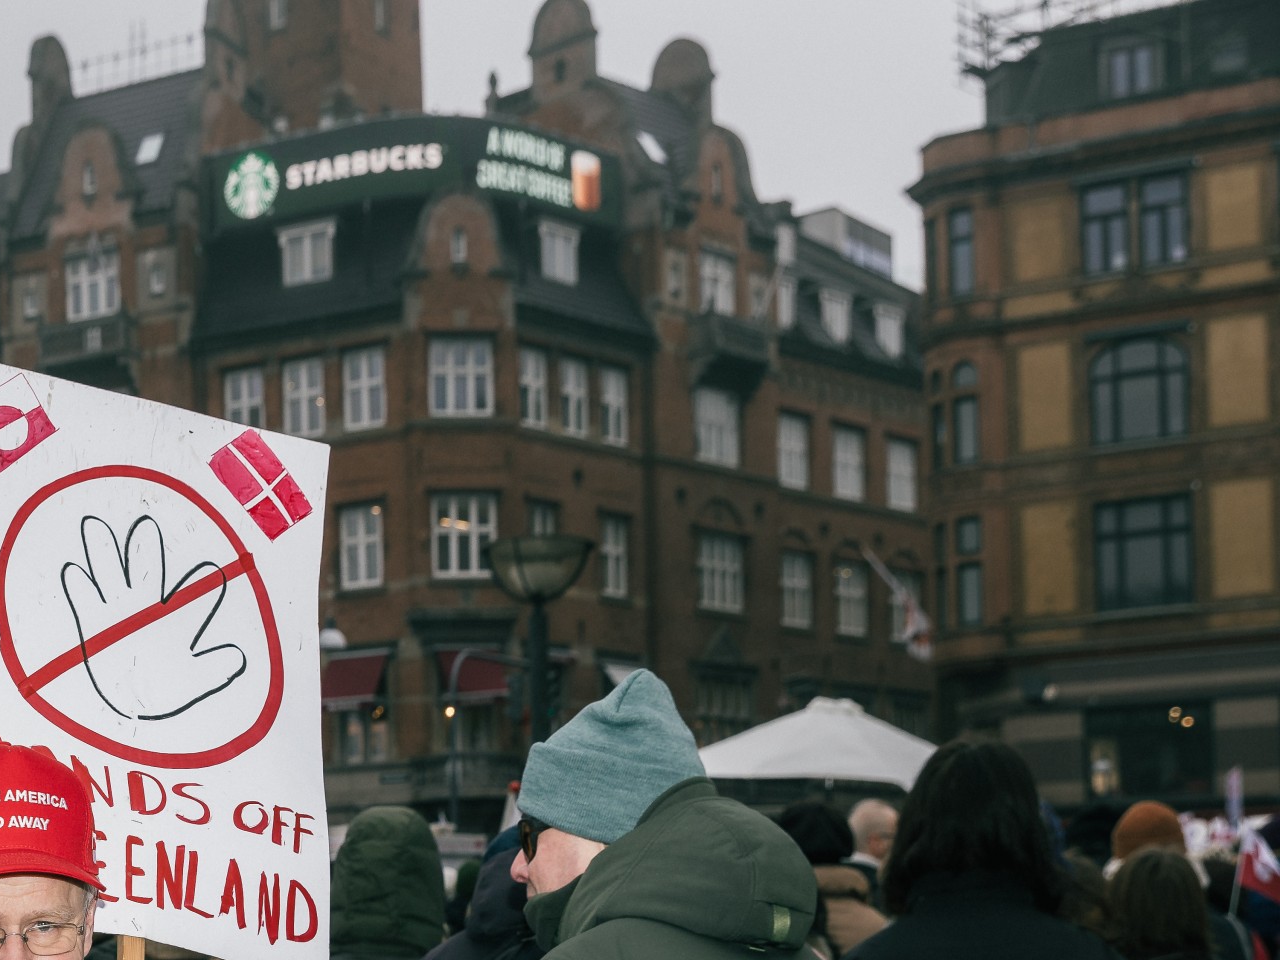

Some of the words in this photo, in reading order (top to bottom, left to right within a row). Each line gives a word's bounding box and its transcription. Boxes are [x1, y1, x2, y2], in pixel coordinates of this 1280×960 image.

[285, 143, 443, 190] STARBUCKS
[4, 789, 68, 810] AMERICA
[8, 815, 50, 831] AWAY
[233, 800, 314, 854] OFF
